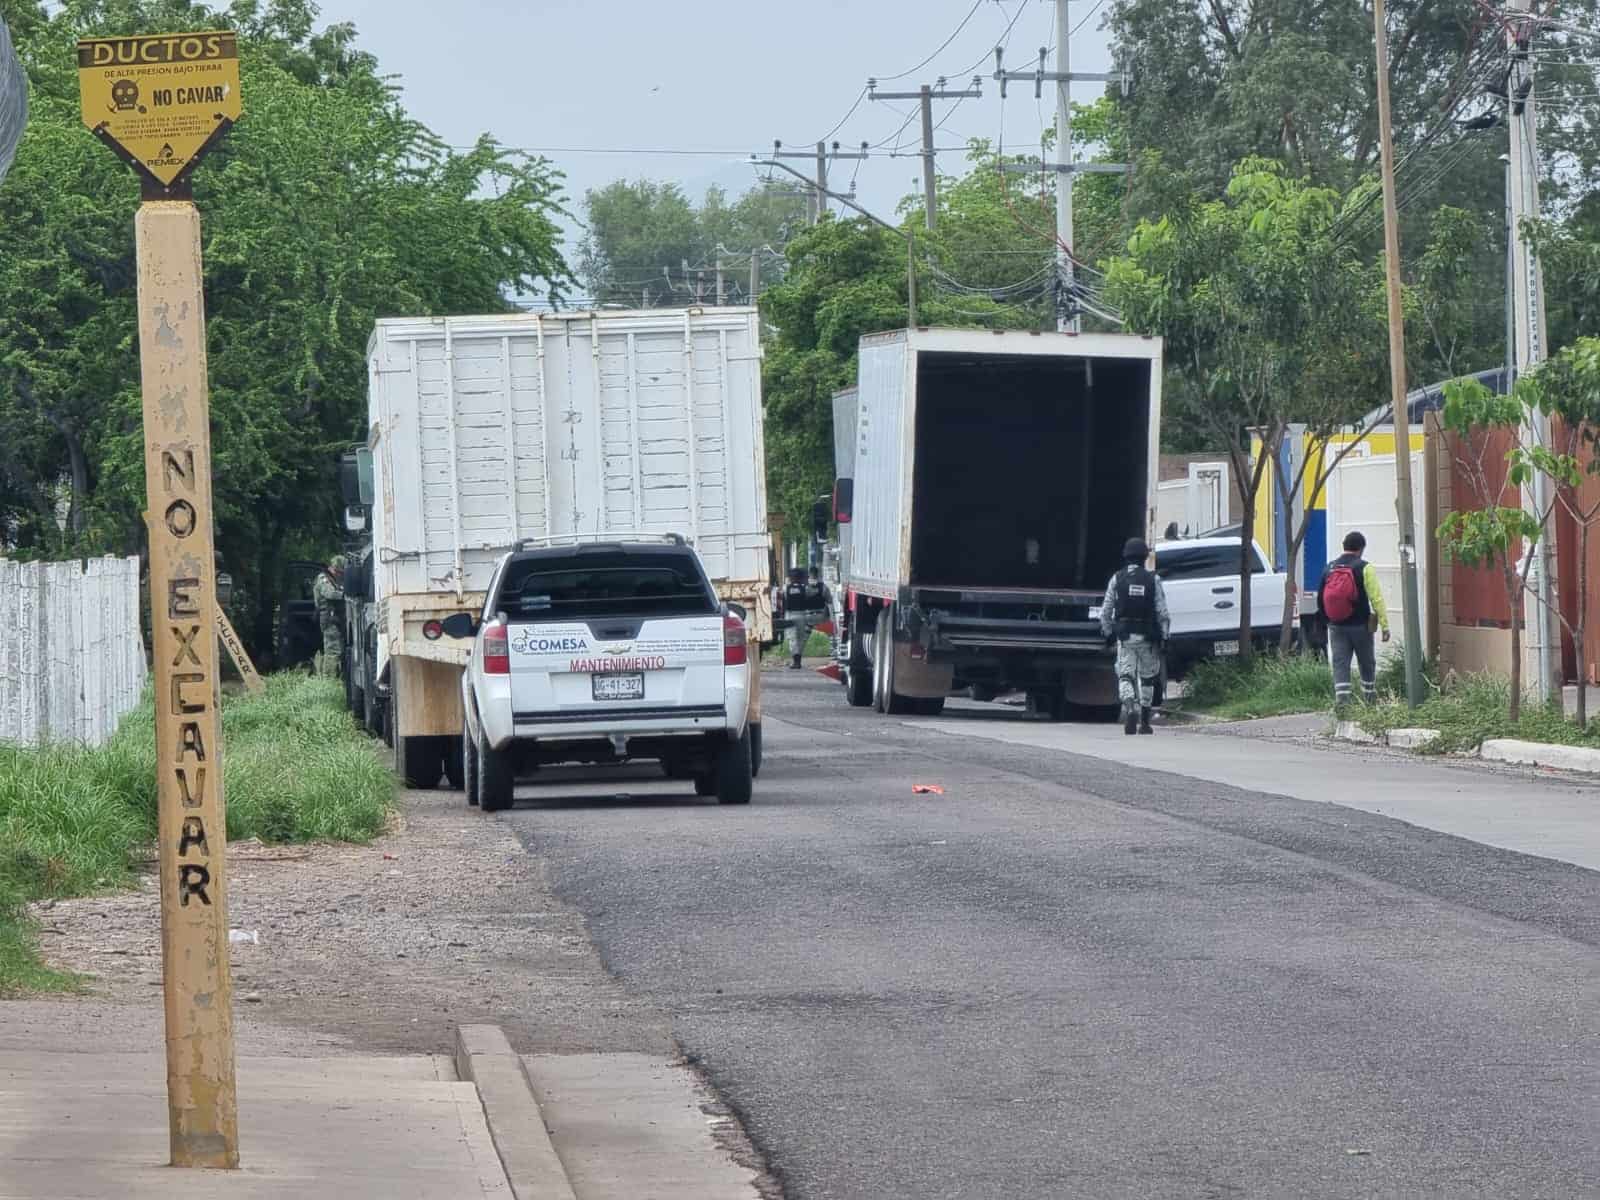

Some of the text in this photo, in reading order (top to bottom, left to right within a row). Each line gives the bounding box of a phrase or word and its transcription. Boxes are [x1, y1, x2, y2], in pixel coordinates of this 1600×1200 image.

[94, 36, 221, 65] DUCTOS
[104, 63, 222, 78] DE ALTA PRESION BAJO TIERRA
[152, 85, 224, 107] NO CAVAR
[146, 157, 185, 167] PEMEX
[529, 638, 588, 651] COMESA
[569, 656, 665, 673] MANTENIMIENTO
[161, 450, 212, 907] NO EXCAVAR
